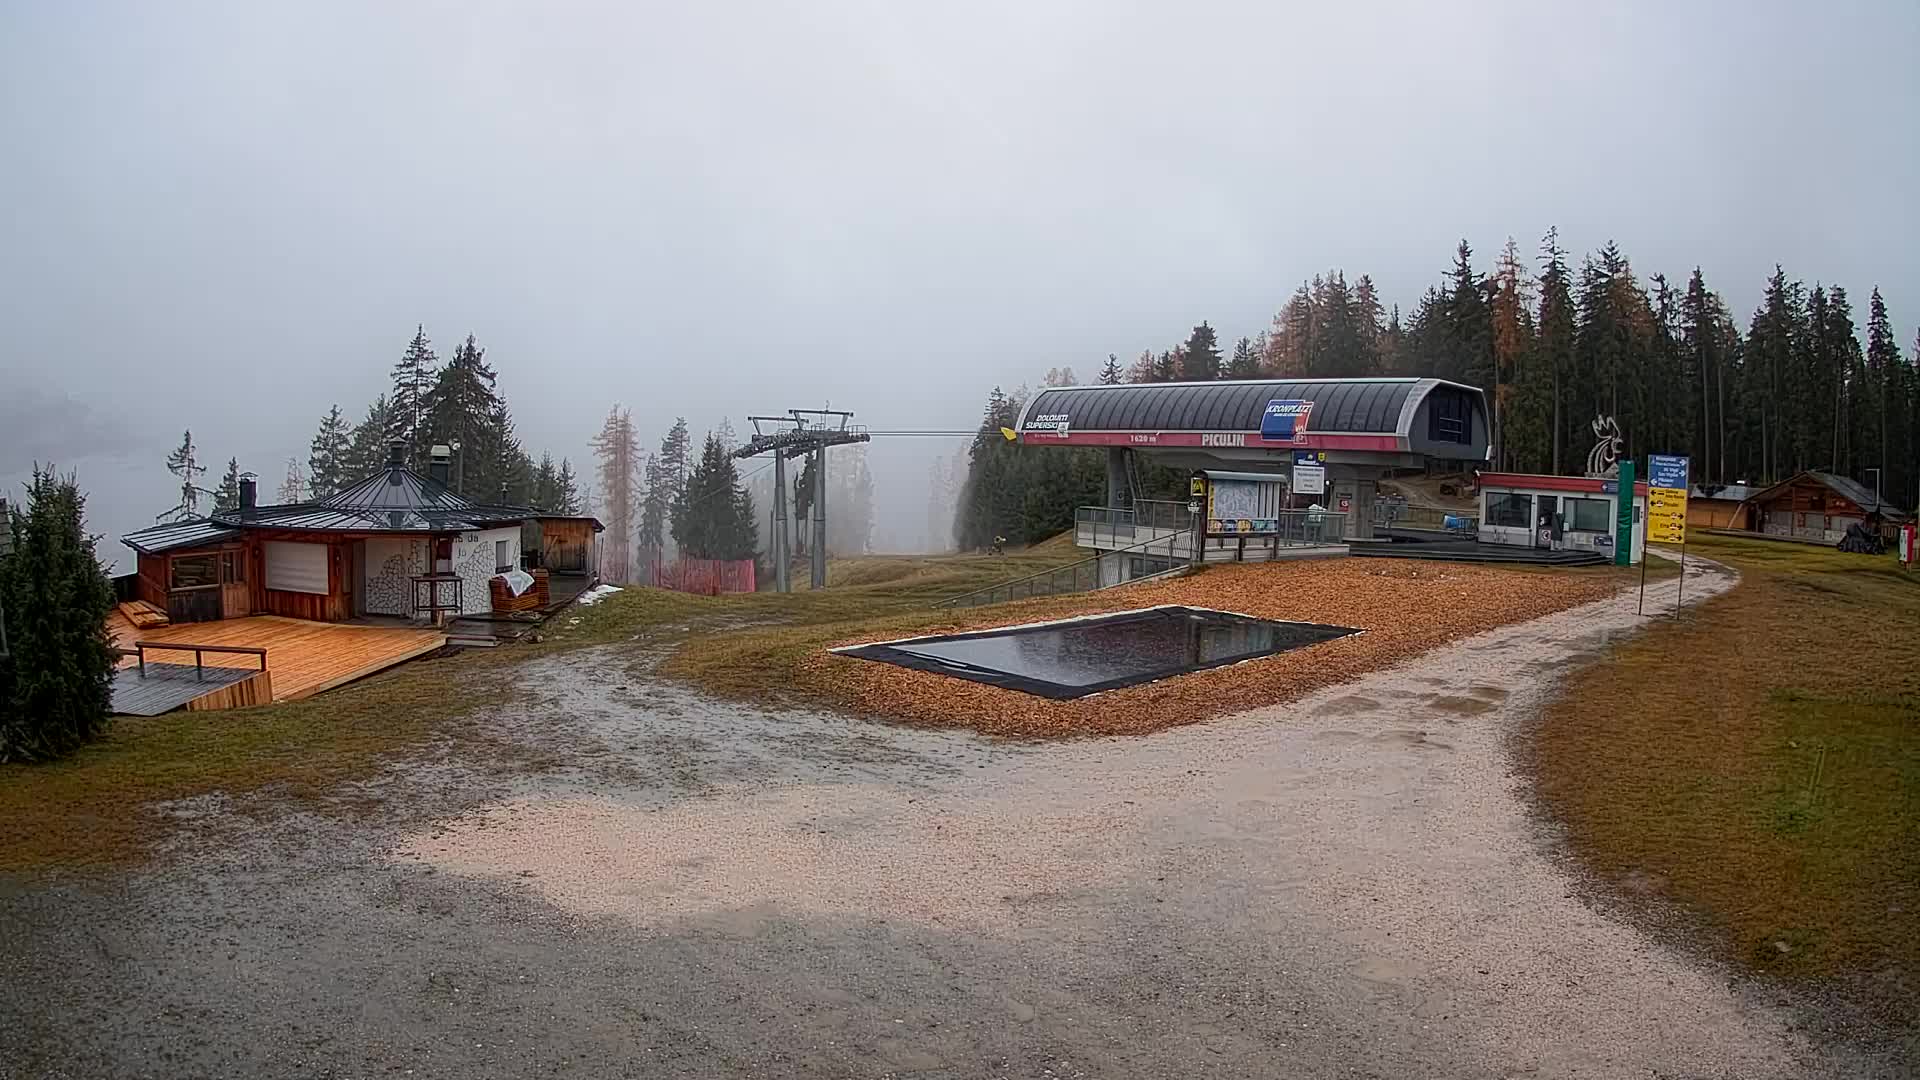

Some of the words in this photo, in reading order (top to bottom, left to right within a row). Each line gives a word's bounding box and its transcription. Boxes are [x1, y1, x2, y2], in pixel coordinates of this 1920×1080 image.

[1268, 405, 1311, 413] KRONPLATZ
[1036, 414, 1069, 422] DOLOMITI
[1130, 435, 1148, 443] 1620
[1202, 434, 1245, 447] PICULIN
